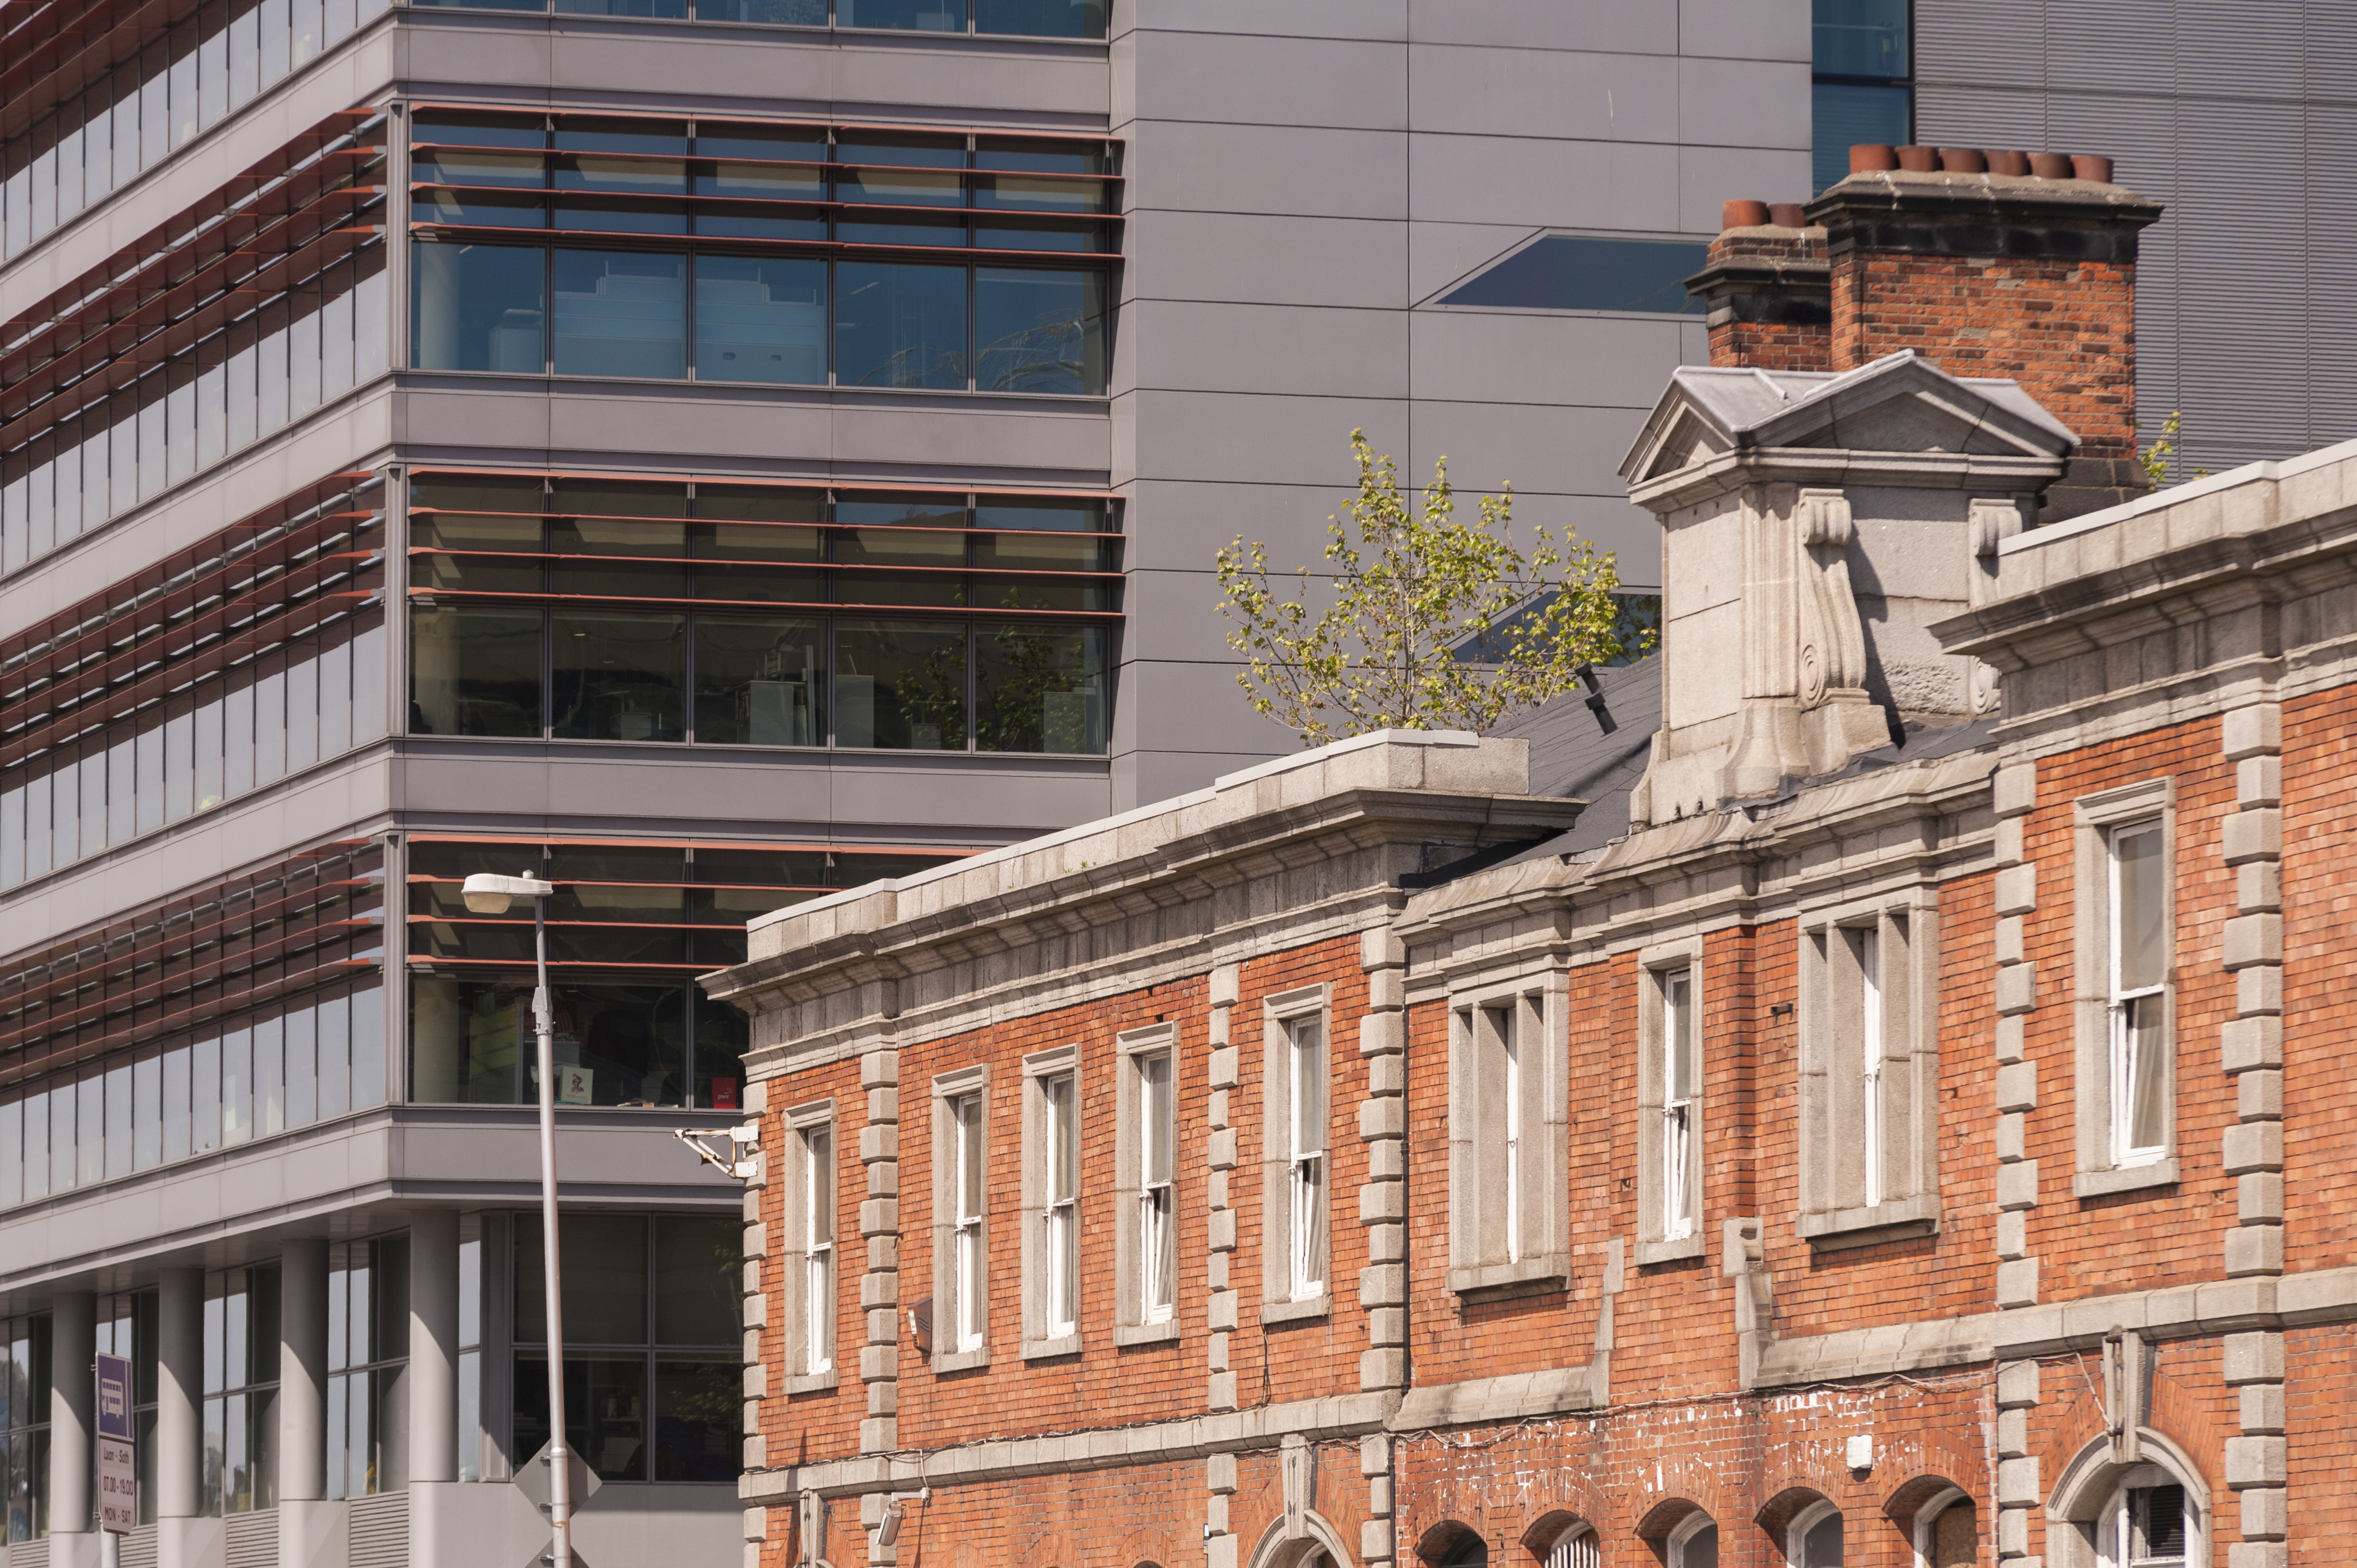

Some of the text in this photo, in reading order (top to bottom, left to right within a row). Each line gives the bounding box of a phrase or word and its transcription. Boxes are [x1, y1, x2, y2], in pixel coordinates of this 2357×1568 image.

[104, 1447, 114, 1461] Luan
[104, 1506, 116, 1522] MON
[122, 1509, 131, 1524] SAT
